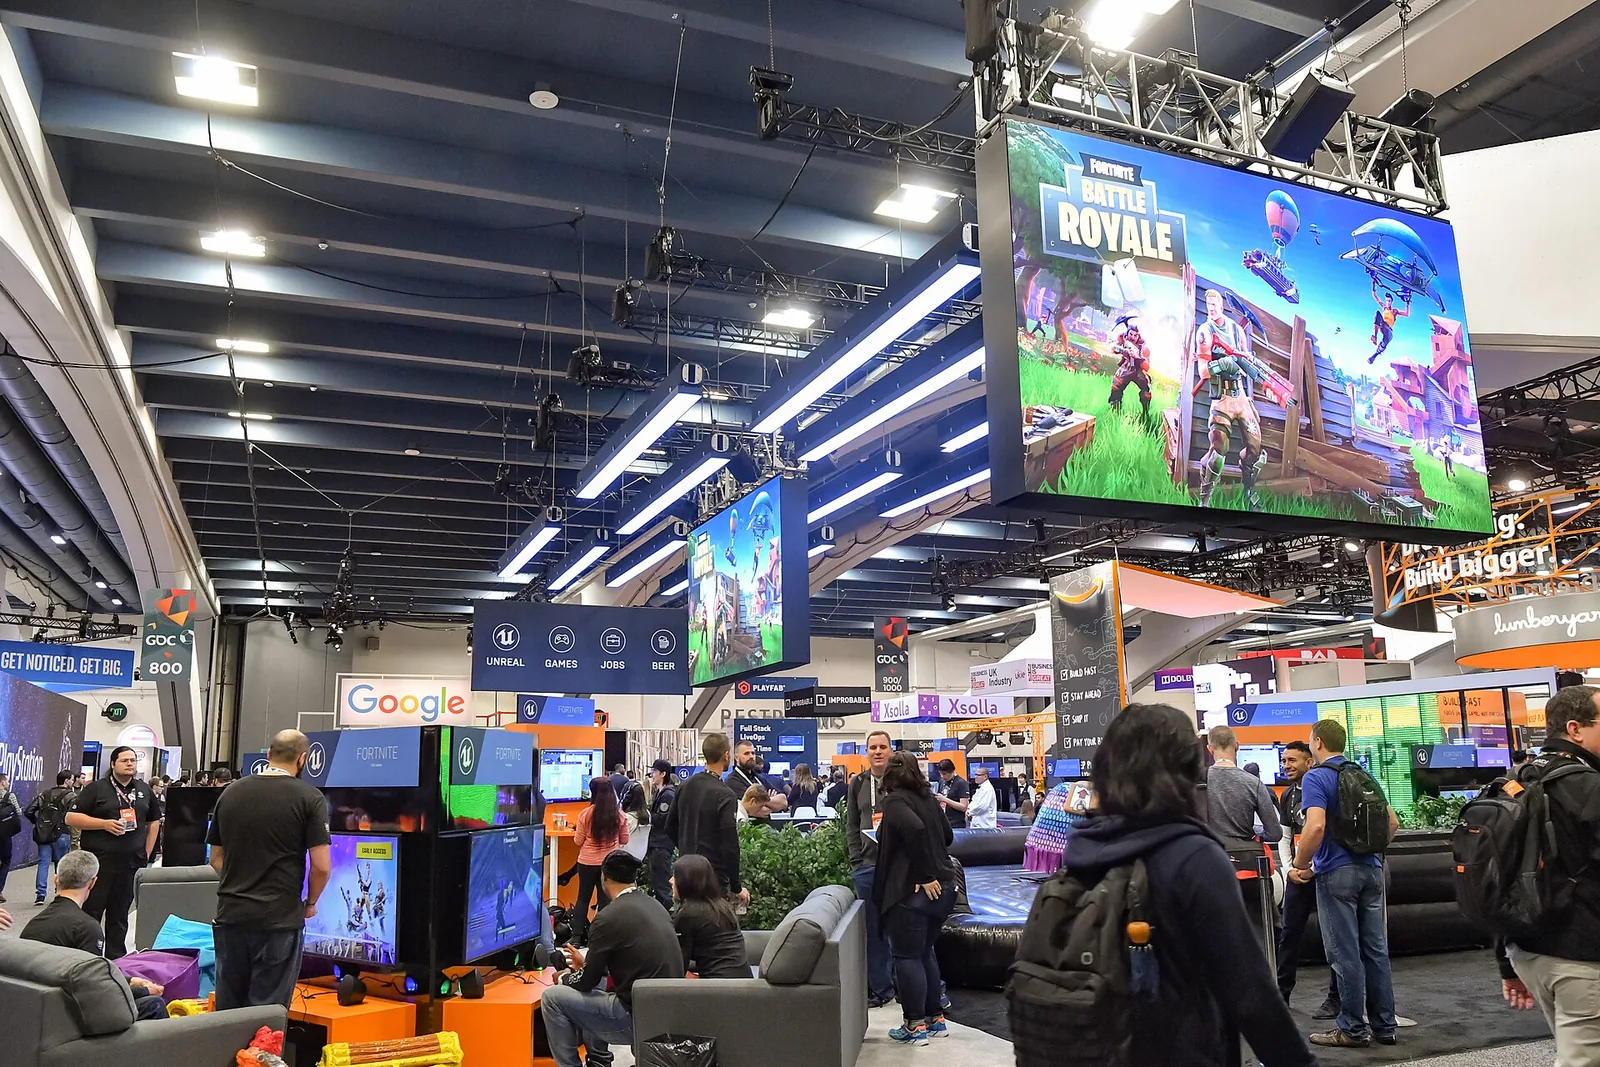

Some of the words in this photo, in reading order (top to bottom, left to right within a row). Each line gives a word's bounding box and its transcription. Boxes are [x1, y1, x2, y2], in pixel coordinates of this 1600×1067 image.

[1089, 158, 1135, 182] FORTNITE
[1081, 178, 1147, 215] BATTLE
[1058, 201, 1174, 262] ROYALE
[1493, 511, 1525, 539] ig.
[1405, 556, 1453, 590] Build
[1458, 544, 1557, 579] bigger.
[1493, 605, 1600, 637] lumberyar
[145, 634, 177, 646] GDC
[0, 651, 24, 669] GET
[25, 653, 78, 673] NOTICED.
[79, 657, 101, 675] GET
[102, 659, 124, 676] BIG.
[486, 656, 525, 667] UNREAL
[544, 659, 578, 669] GAMES
[600, 660, 626, 670] JOBS
[876, 655, 898, 665] GDC
[148, 662, 183, 675] 800
[652, 661, 676, 670] BEER
[1083, 666, 1097, 675] FAST
[988, 668, 998, 678] UK
[882, 676, 903, 685] 900/
[988, 677, 1013, 687] Industry
[752, 684, 785, 692] PLAYFAB
[882, 684, 903, 692] 1000
[828, 696, 871, 704] IMPROBABLE
[1070, 691, 1084, 701] STAY
[347, 684, 465, 722] Google
[948, 698, 998, 715] Xsolla
[557, 705, 584, 715] FORTNITE
[883, 700, 910, 719] Xsolla
[1271, 708, 1303, 717] FORTNITE
[740, 734, 766, 742] LiveOps
[1073, 738, 1083, 747] PAY
[918, 740, 935, 750] Spat
[356, 745, 399, 760] FORTNITE
[495, 747, 522, 761] FORTNITE
